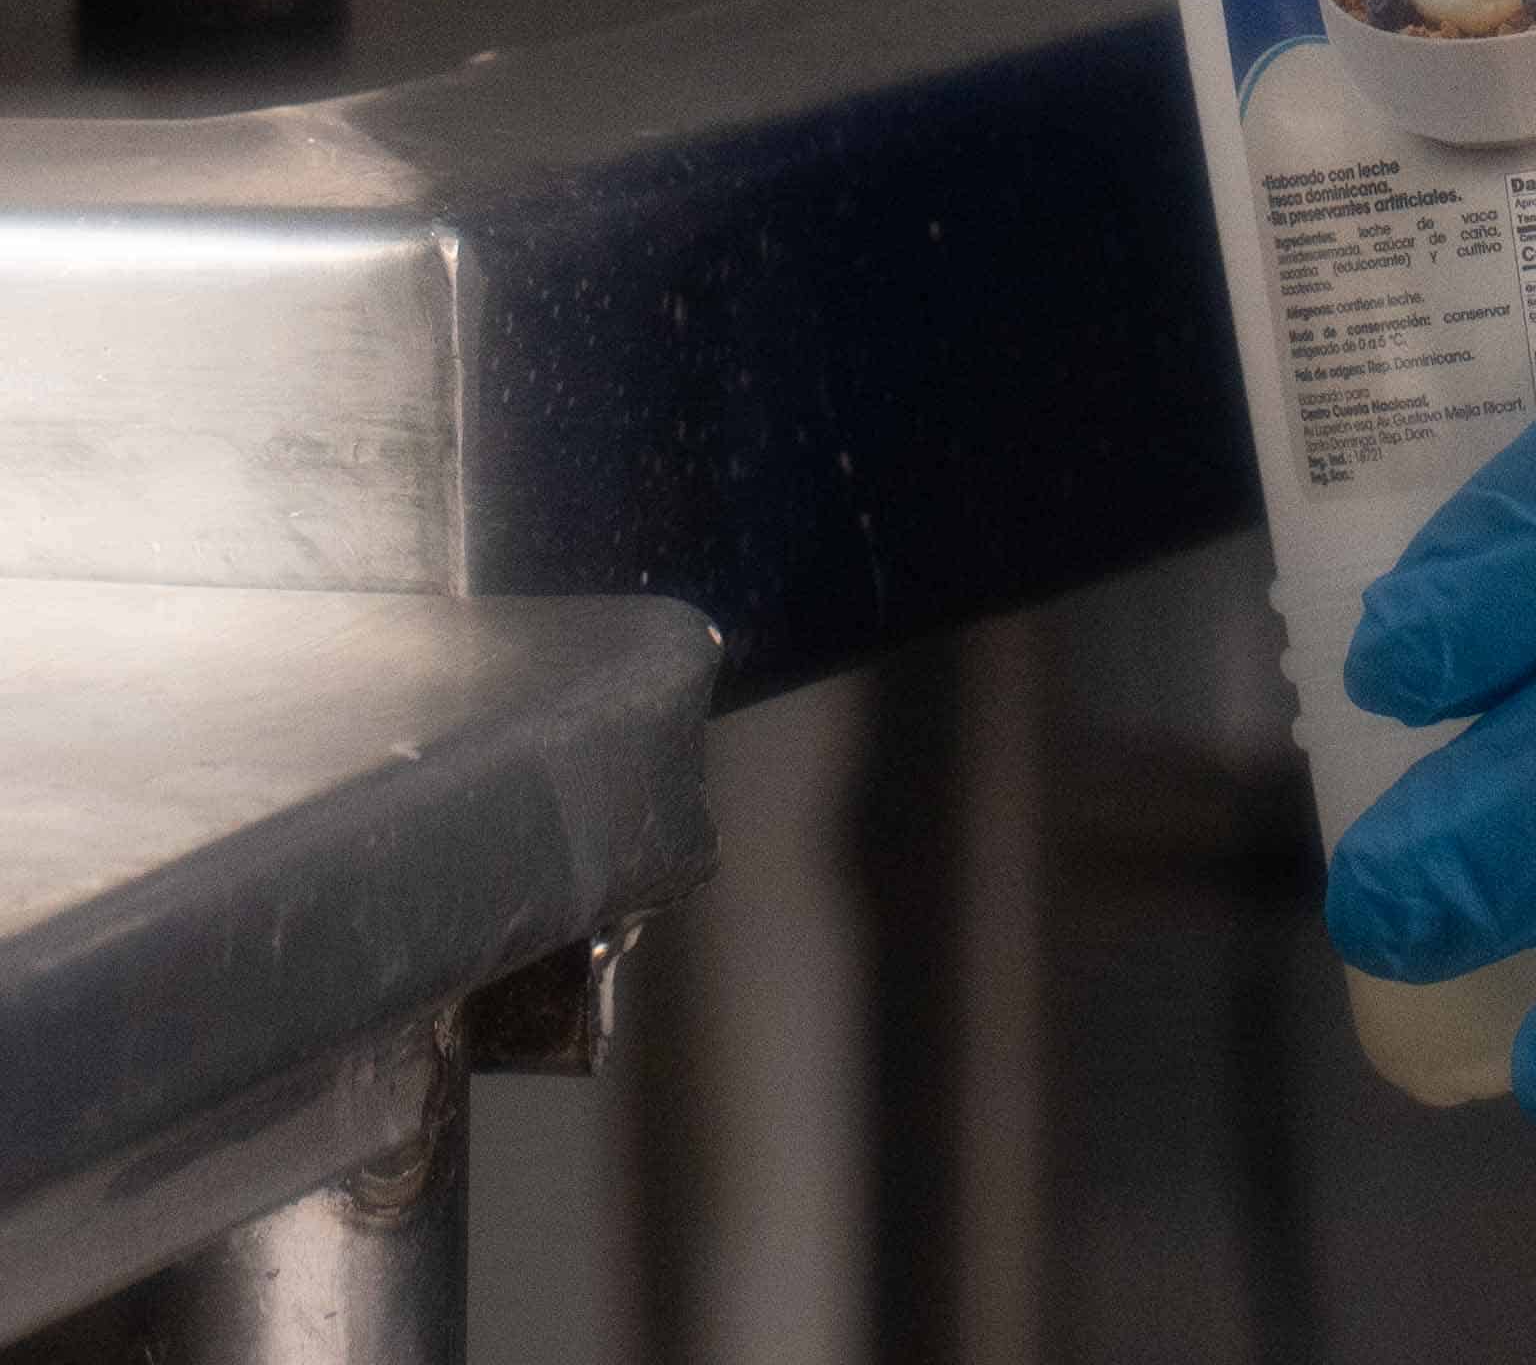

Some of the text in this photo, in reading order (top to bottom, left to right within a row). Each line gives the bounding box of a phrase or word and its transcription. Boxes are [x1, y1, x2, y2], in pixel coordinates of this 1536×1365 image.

[1328, 165, 1354, 183] con
[1357, 158, 1400, 177] leche
[1304, 180, 1393, 203] dominicana.
[1374, 188, 1463, 214] artificiales.
[1358, 223, 1392, 238] leche
[1416, 215, 1434, 231] de
[1461, 210, 1498, 225] vaca
[1429, 231, 1447, 247] de
[1456, 241, 1503, 259] cultivo
[1443, 304, 1511, 324] conservar
